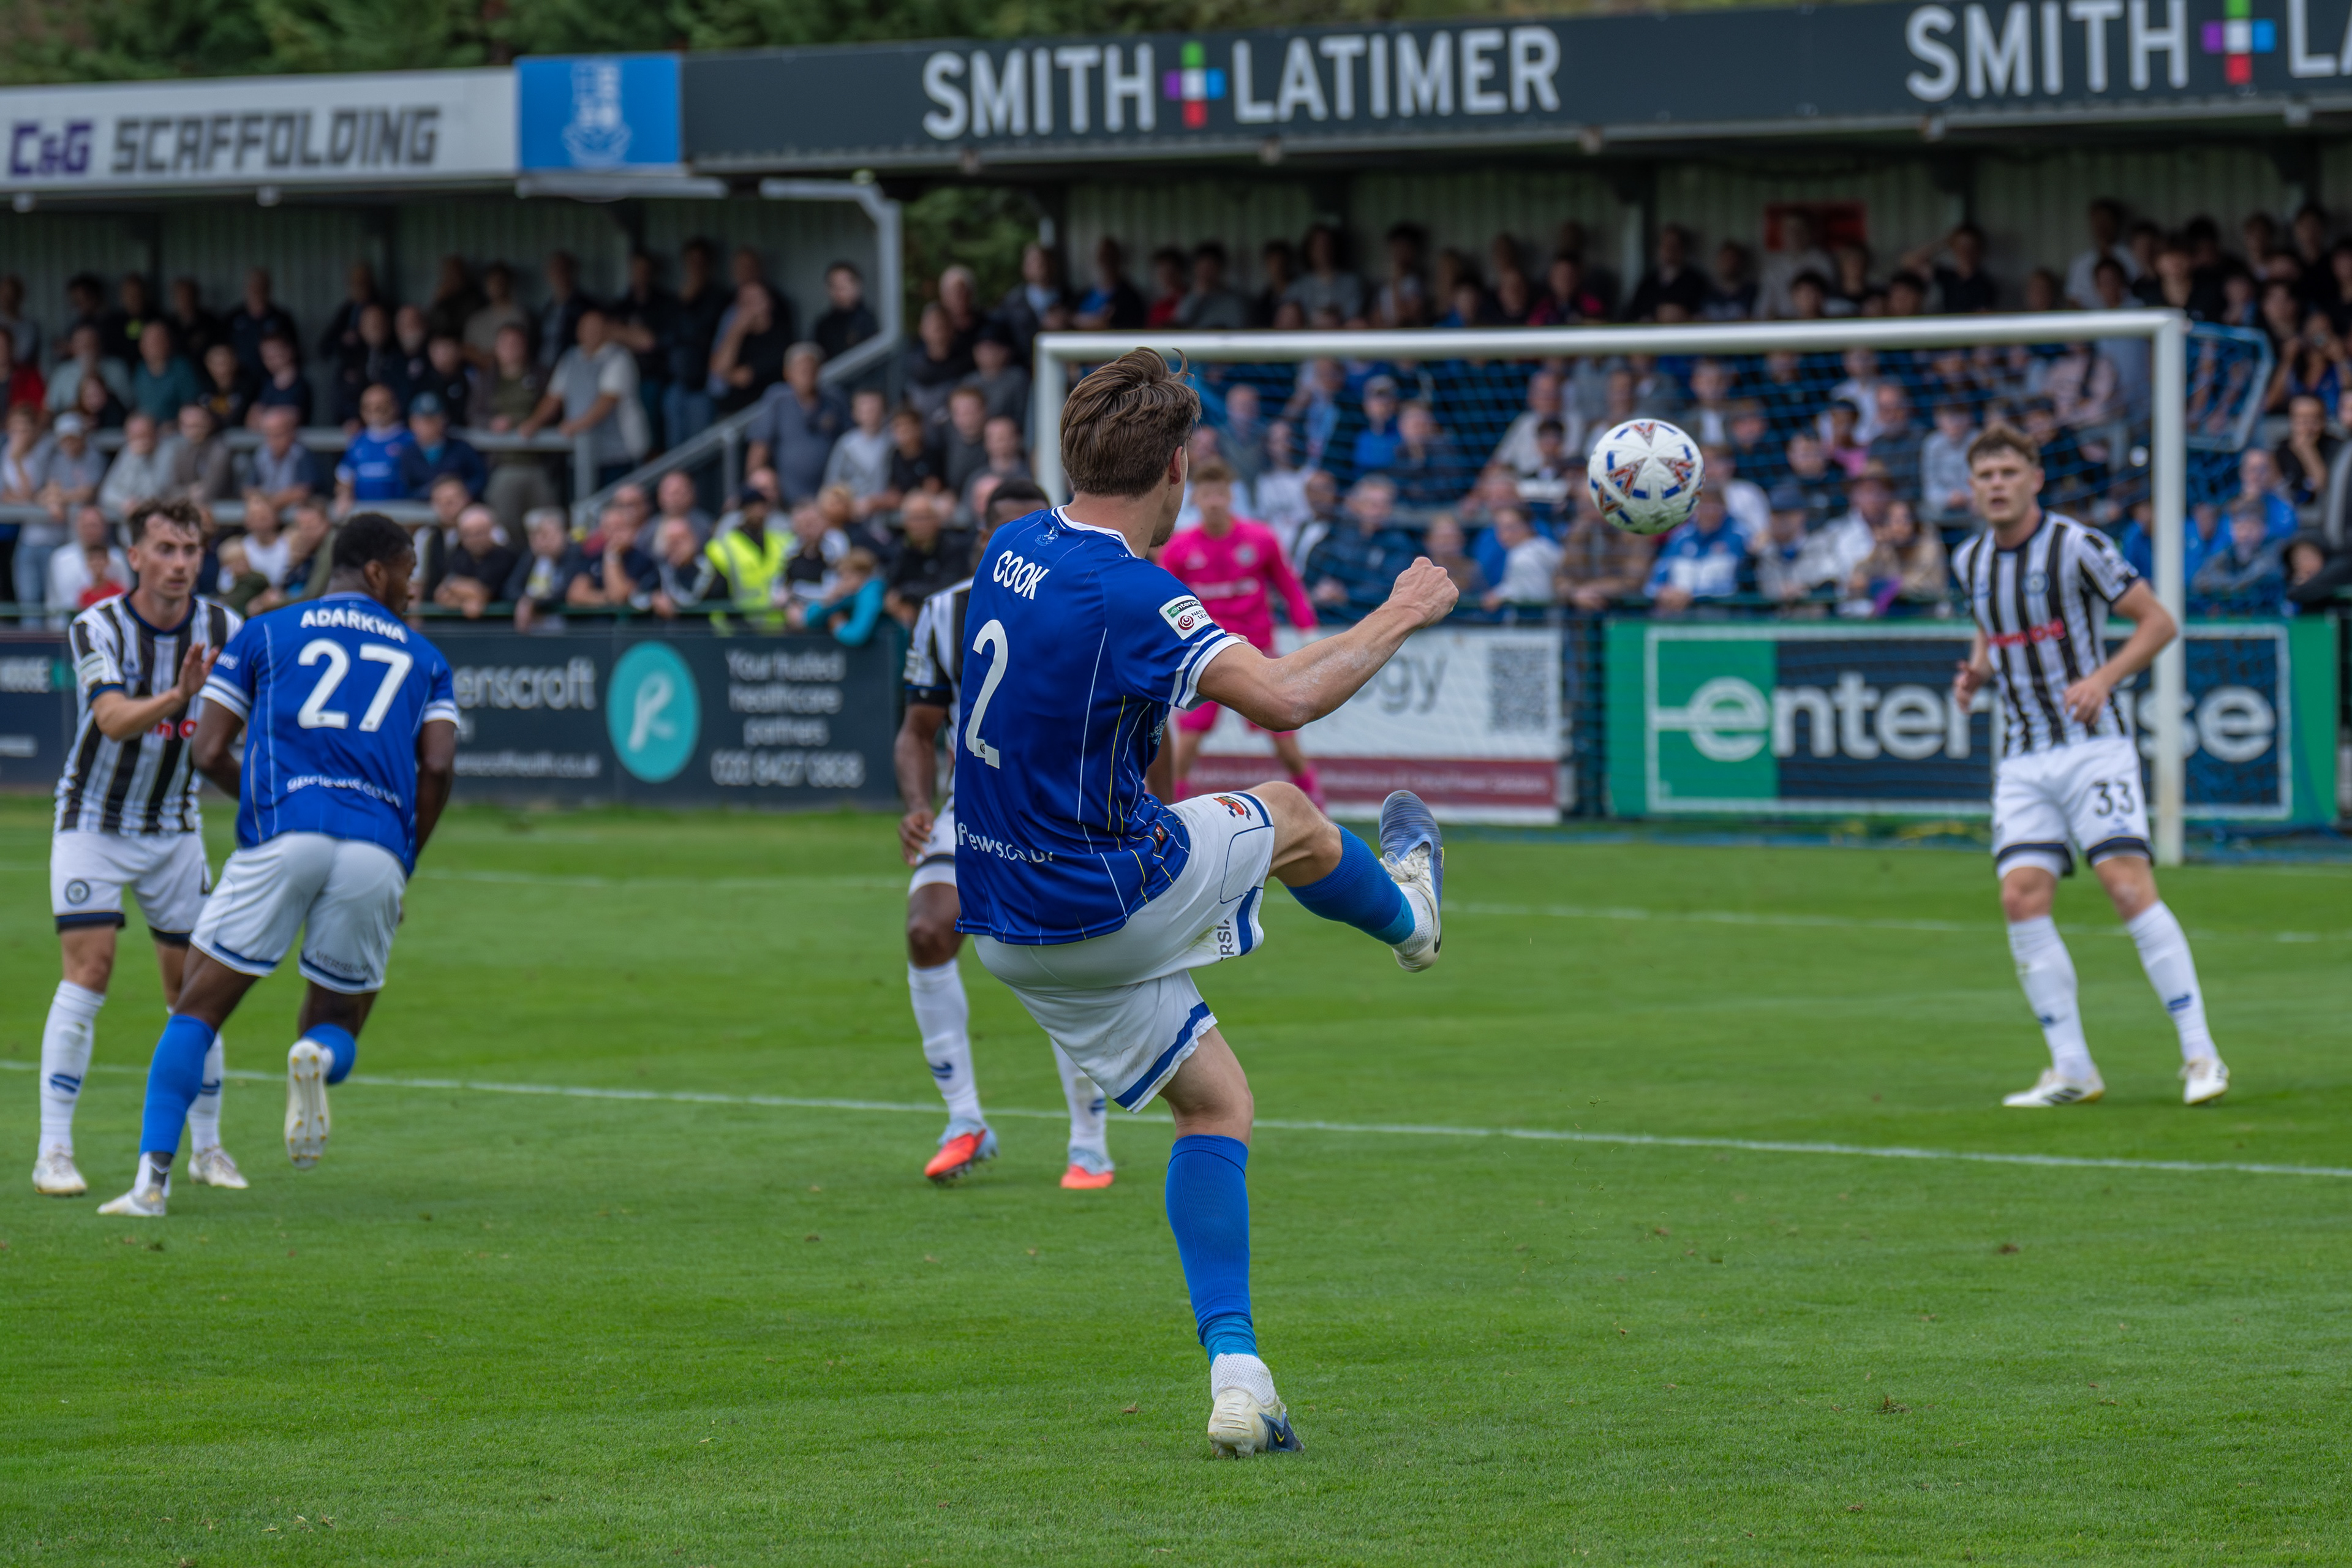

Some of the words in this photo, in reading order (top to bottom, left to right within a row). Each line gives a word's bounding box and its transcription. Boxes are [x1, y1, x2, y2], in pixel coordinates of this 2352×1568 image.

[922, 42, 1156, 140] SMITH
[1231, 26, 1561, 123] LATIMER
[1904, 0, 2189, 101] SMITH
[2286, 0, 2352, 78] L
[9, 122, 94, 176] C&G
[110, 107, 441, 173] SCAFFOLDING
[993, 550, 1050, 600] COOK
[300, 607, 408, 643] ADARKWA
[297, 638, 413, 732] 27
[965, 619, 1008, 769] 2
[2090, 779, 2135, 817] 33
